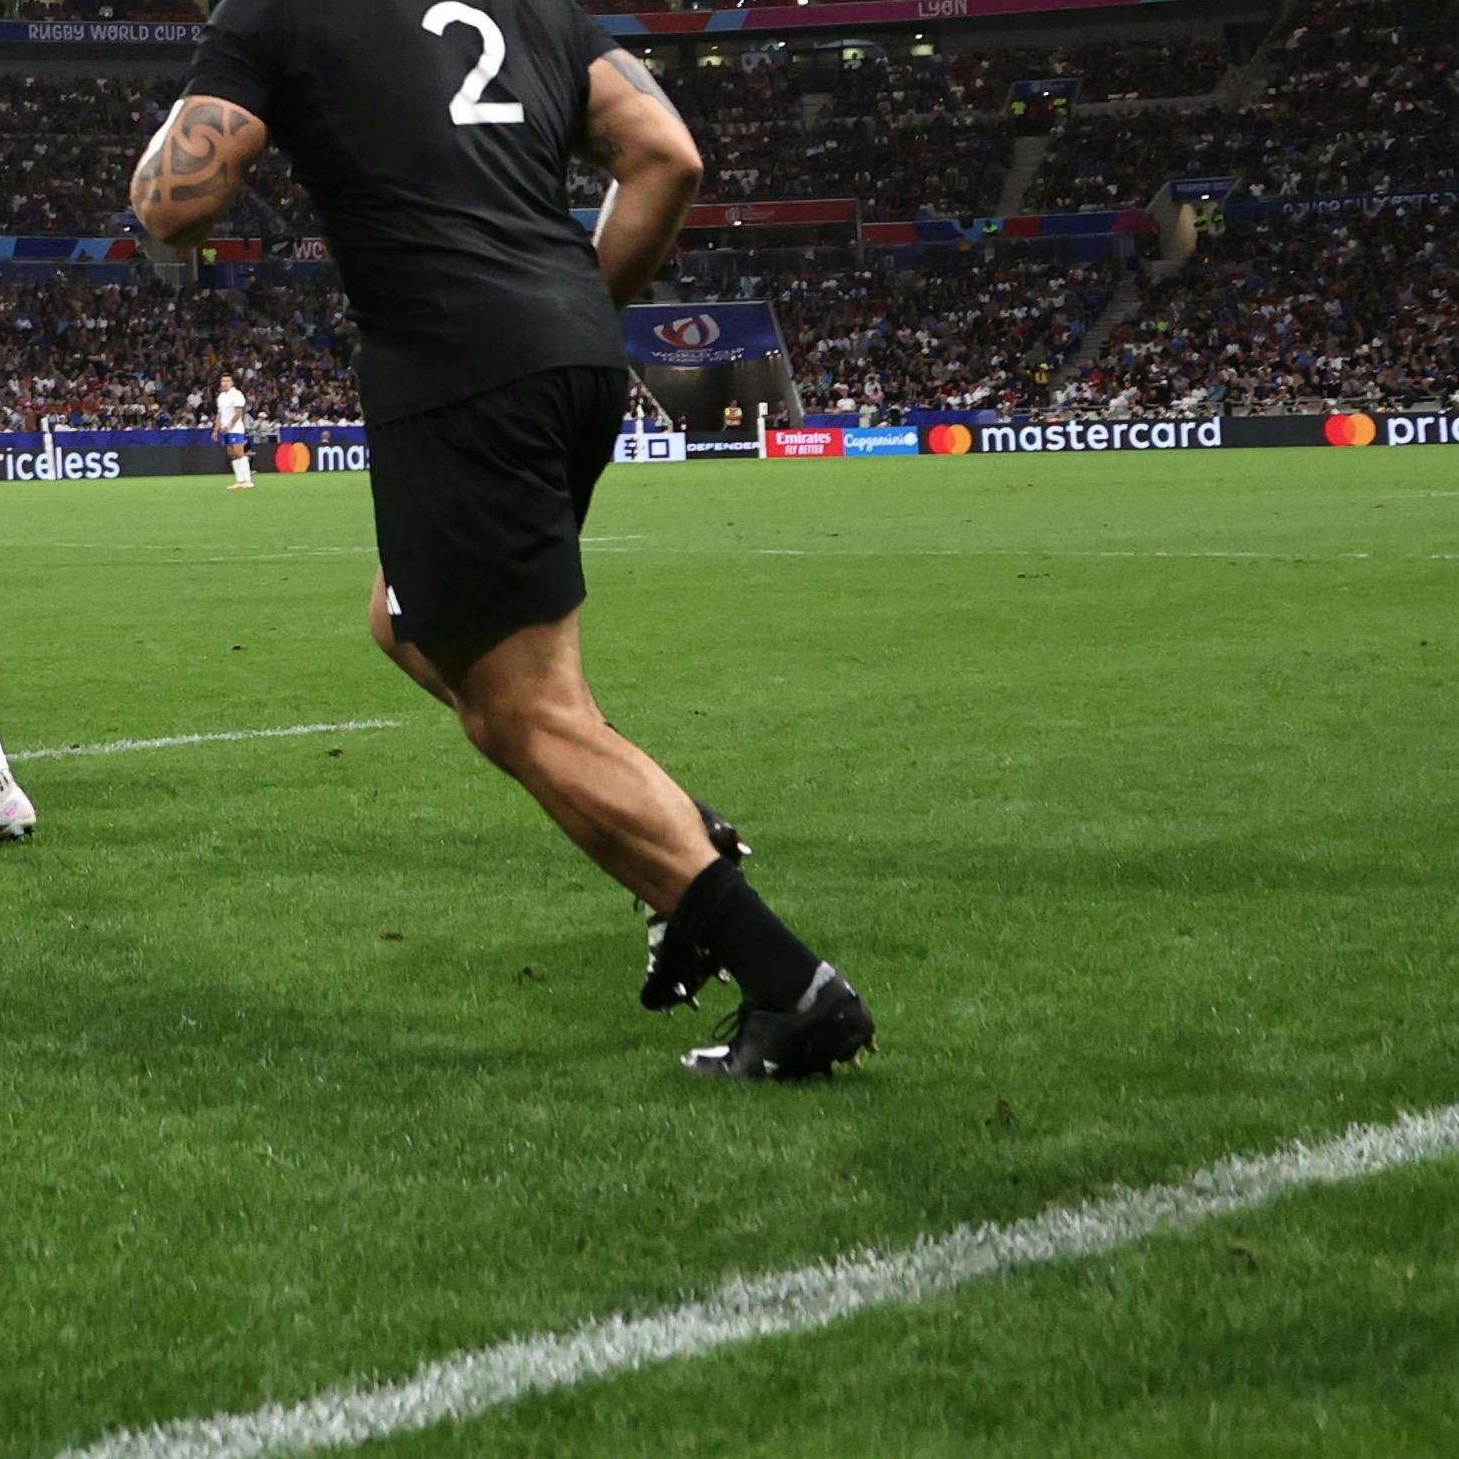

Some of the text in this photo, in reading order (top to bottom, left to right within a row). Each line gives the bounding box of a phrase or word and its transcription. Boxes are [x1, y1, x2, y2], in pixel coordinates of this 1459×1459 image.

[28, 24, 85, 42] RUGBY
[89, 24, 150, 42] WORLD
[154, 25, 187, 41] CUP
[422, 1, 525, 125] 2
[776, 431, 832, 445] Emirates
[844, 433, 905, 452] Capgemini
[982, 416, 1222, 452] mastercard
